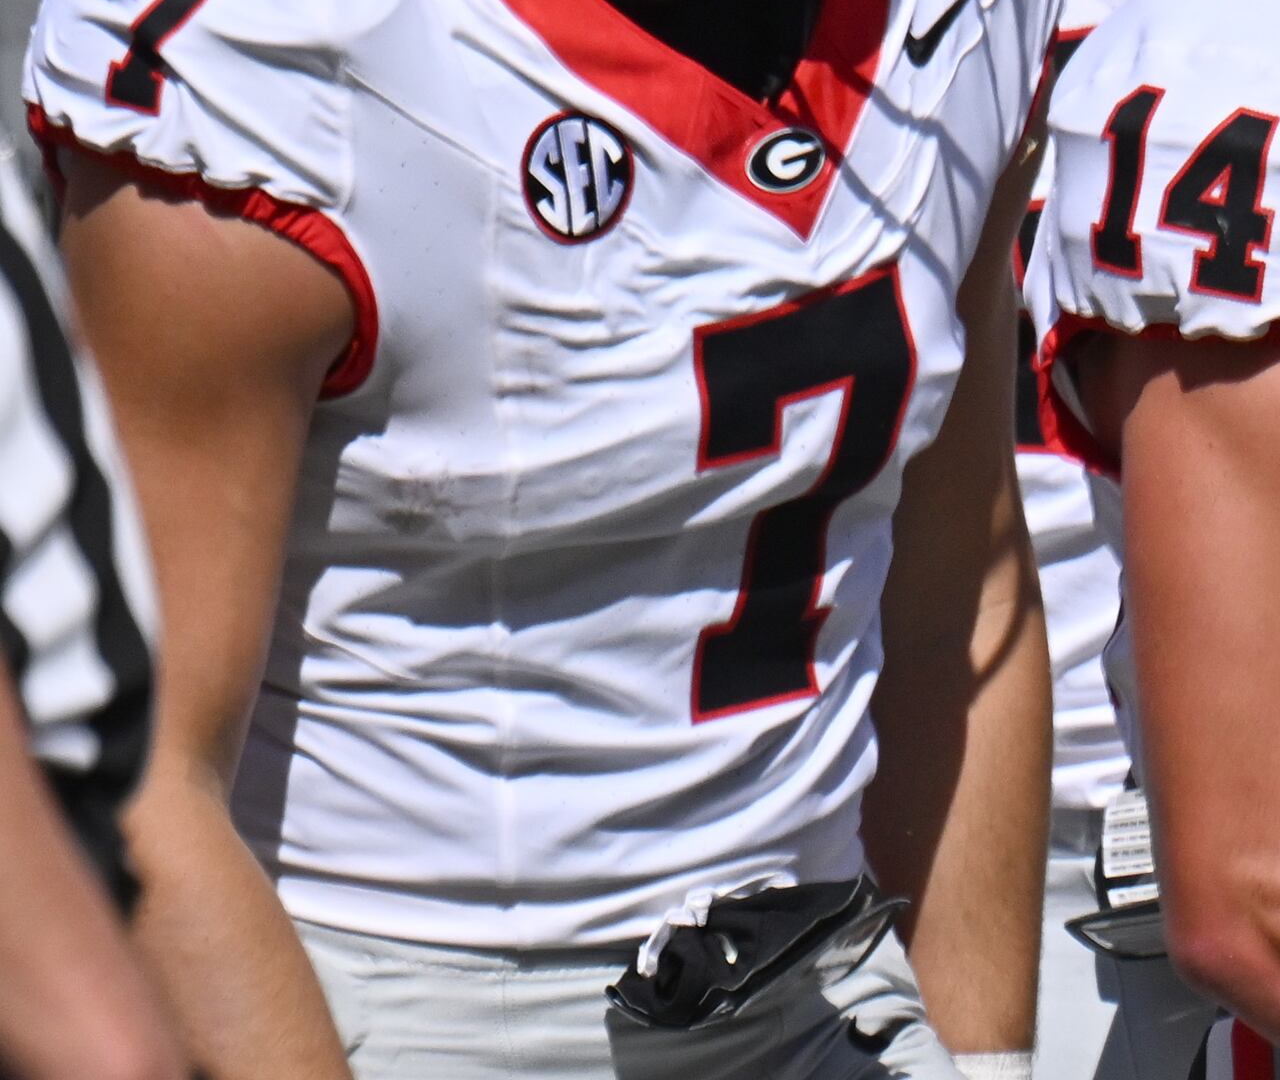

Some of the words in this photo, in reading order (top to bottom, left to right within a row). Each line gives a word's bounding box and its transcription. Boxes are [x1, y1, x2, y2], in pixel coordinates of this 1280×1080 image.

[528, 117, 630, 234] SEC
[749, 129, 824, 192] G
[1090, 83, 1280, 304] 14
[691, 264, 919, 723] 7
